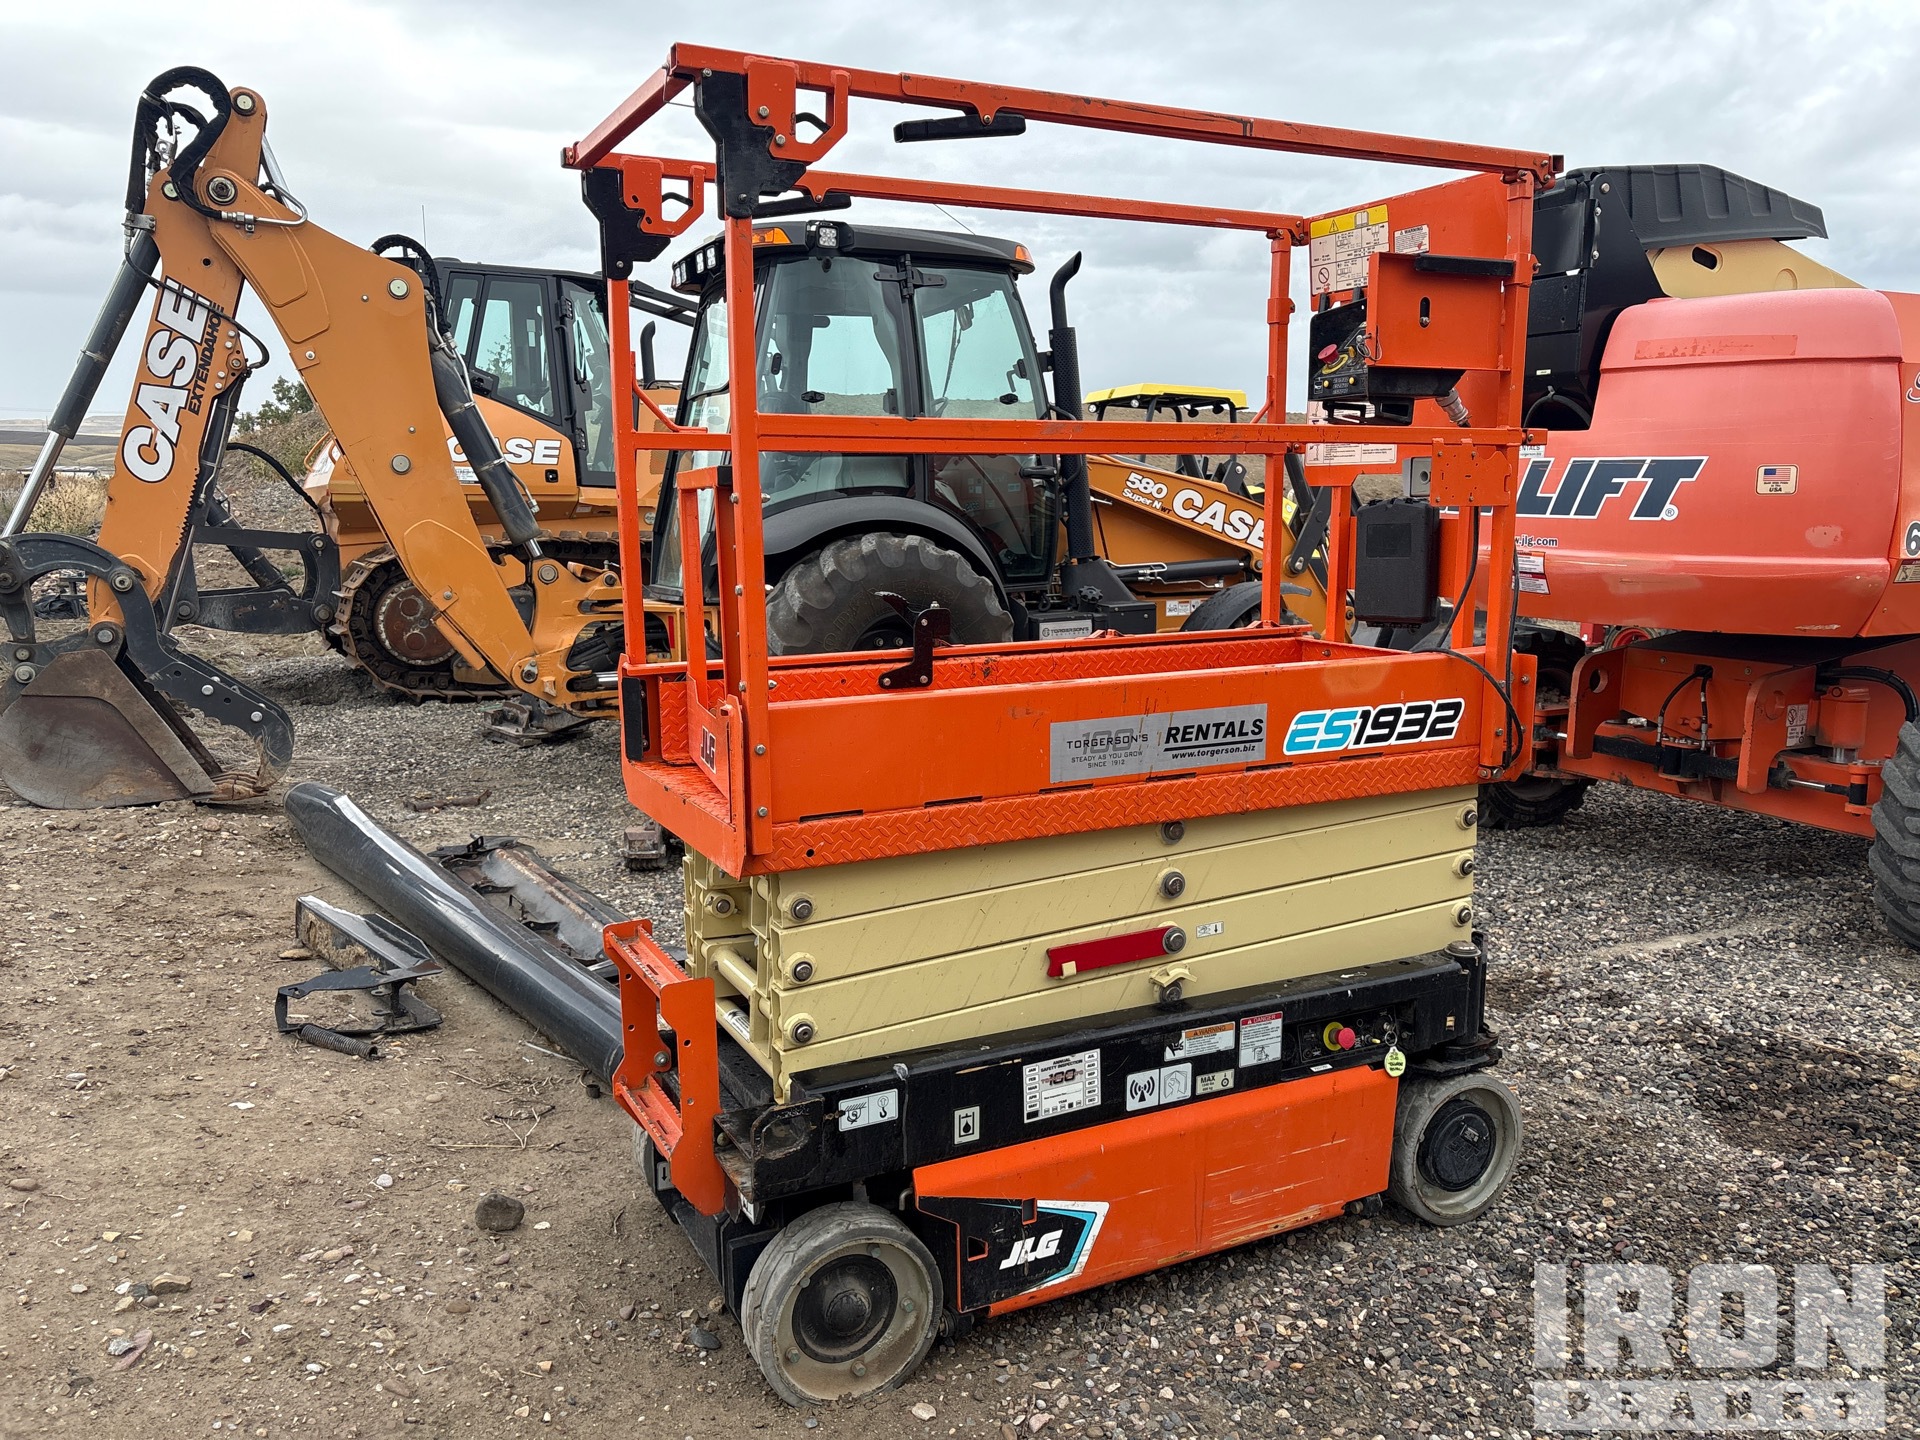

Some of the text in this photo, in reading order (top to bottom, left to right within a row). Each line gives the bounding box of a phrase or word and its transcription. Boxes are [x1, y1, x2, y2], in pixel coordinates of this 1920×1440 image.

[188, 302, 225, 416] EXTENDAHOE
[121, 275, 212, 484] CASE
[1125, 471, 1169, 499] 580
[1516, 456, 1709, 520] LIFT
[1122, 487, 1153, 505] Super
[1164, 718, 1264, 745] RENTALS
[1283, 698, 1465, 756] ES1932
[700, 726, 716, 775] JLG
[1066, 733, 1149, 750] TORGERSON'S
[1071, 755, 1096, 764] STEADY
[1108, 752, 1122, 760] YOU
[1123, 750, 1143, 758] GROW
[1171, 744, 1256, 760] www.torgerson.biz
[1087, 761, 1107, 769] SINCE
[1253, 1014, 1276, 1024] DANGER
[1199, 1025, 1226, 1036] WARNING
[1057, 1059, 1083, 1069] INSPECTION
[1049, 1068, 1076, 1086] 100
[1200, 1074, 1216, 1084] MAX
[999, 1229, 1063, 1270] JLG
